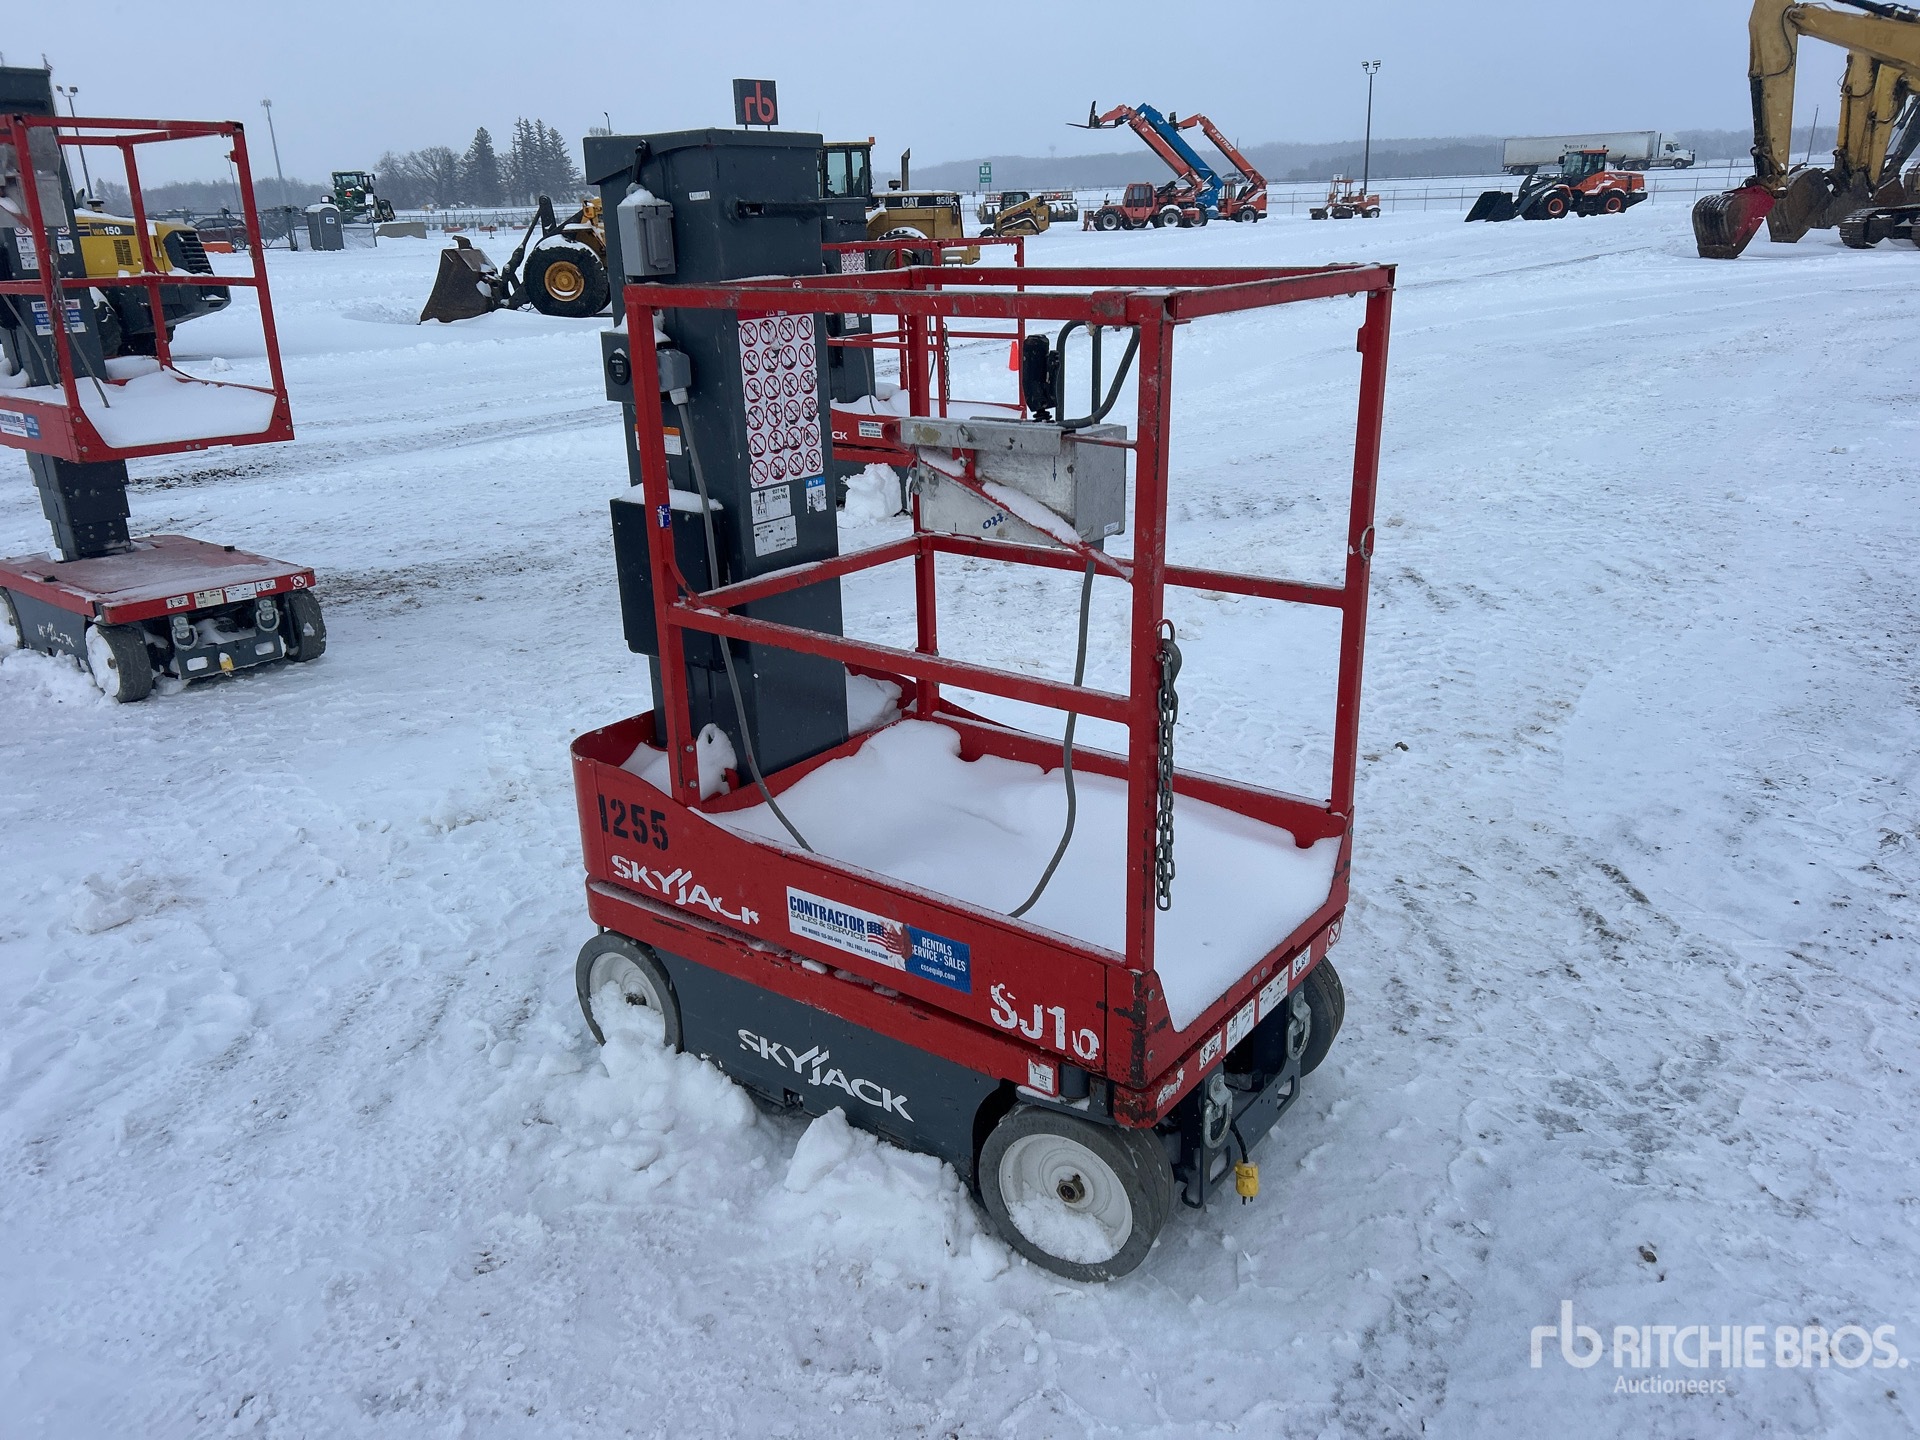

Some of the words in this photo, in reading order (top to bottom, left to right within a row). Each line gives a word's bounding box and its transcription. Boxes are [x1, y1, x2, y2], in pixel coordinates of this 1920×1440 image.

[744, 81, 775, 123] rb
[902, 196, 920, 209] CAT
[92, 226, 121, 236] WA150
[597, 794, 669, 850] 1255
[789, 896, 865, 934] CONTRACTOR
[790, 911, 818, 926] SALES
[818, 920, 826, 929] &
[826, 923, 867, 942] SERVICE
[921, 936, 952, 956] RENTALS
[943, 955, 967, 973] SALES
[737, 1029, 915, 1123] SKYJACK
